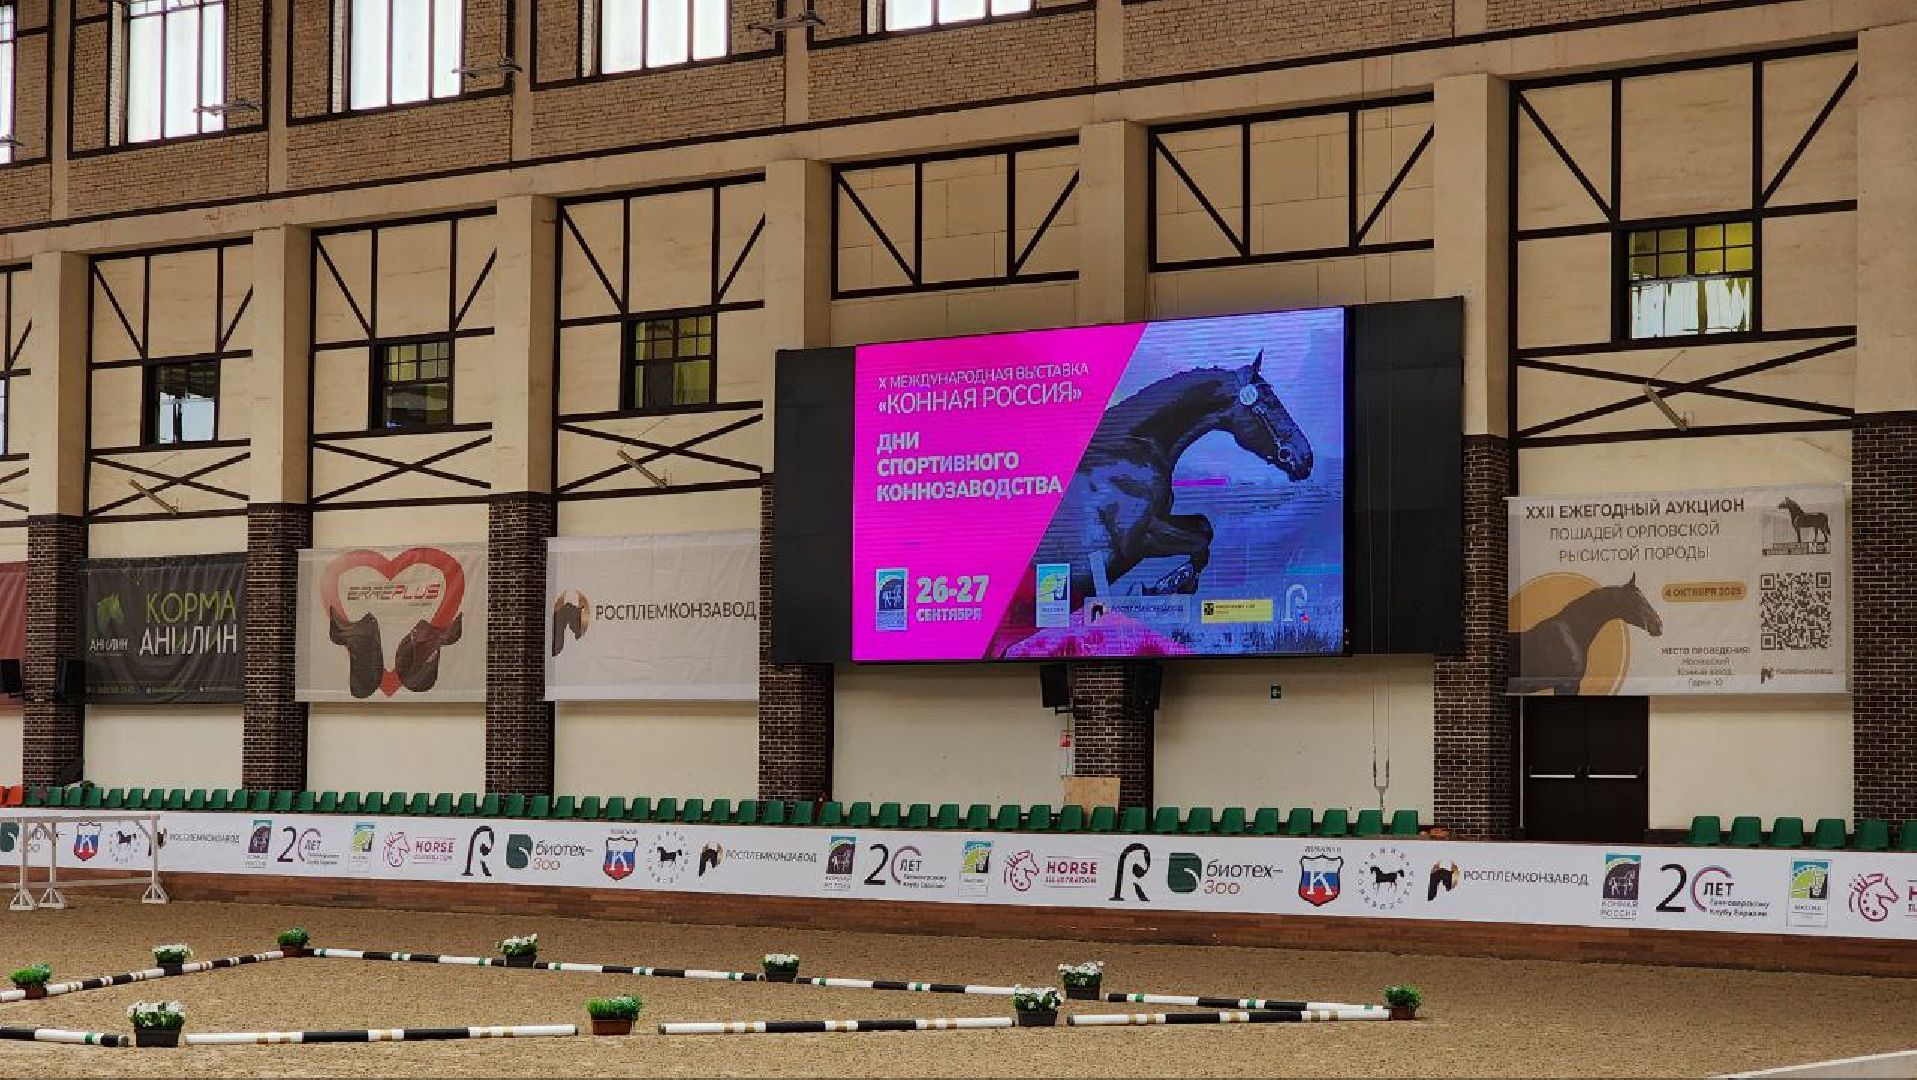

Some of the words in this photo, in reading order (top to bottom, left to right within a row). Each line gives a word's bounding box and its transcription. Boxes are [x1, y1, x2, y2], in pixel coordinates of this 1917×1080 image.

[890, 367, 1013, 388] МЕЖДУНАРОДНАЯ
[1015, 362, 1089, 381] ВЫСТАВКА
[878, 388, 977, 414] «КОННАЯ
[982, 380, 1083, 407] РОССИЯ»
[877, 431, 920, 455] ДНИ
[877, 451, 1019, 477] СПОРТИВНОГО
[876, 475, 1063, 502] КОННОЗАВОДСТВА
[1525, 504, 1554, 520] XXII
[1559, 499, 1661, 520] ЕЖЕГОДНЫЙ
[1665, 497, 1745, 517] АУКЦИОН
[1549, 524, 1622, 542] ЛОШАДЕЙ
[1626, 520, 1720, 540] ОРЛОВСКОЙ
[1559, 544, 1641, 563] РЫСИСТОЙ
[1644, 545, 1710, 561] ПОРОДЫ
[915, 575, 989, 604] 26-27
[146, 589, 238, 624] КОРМА
[595, 601, 757, 621] РОСПЛЕМКОНЗАВОД
[915, 607, 983, 622] СЕНТЯБРЯ
[139, 624, 238, 656] АНИЛИН
[415, 840, 456, 853] HORSE
[900, 859, 922, 872] ЛЕТ
[1046, 861, 1098, 875] HORSE
[1463, 870, 1590, 887] РОСПЛЕМКОНЗАВОД
[1703, 882, 1735, 896] ЛЕТ
